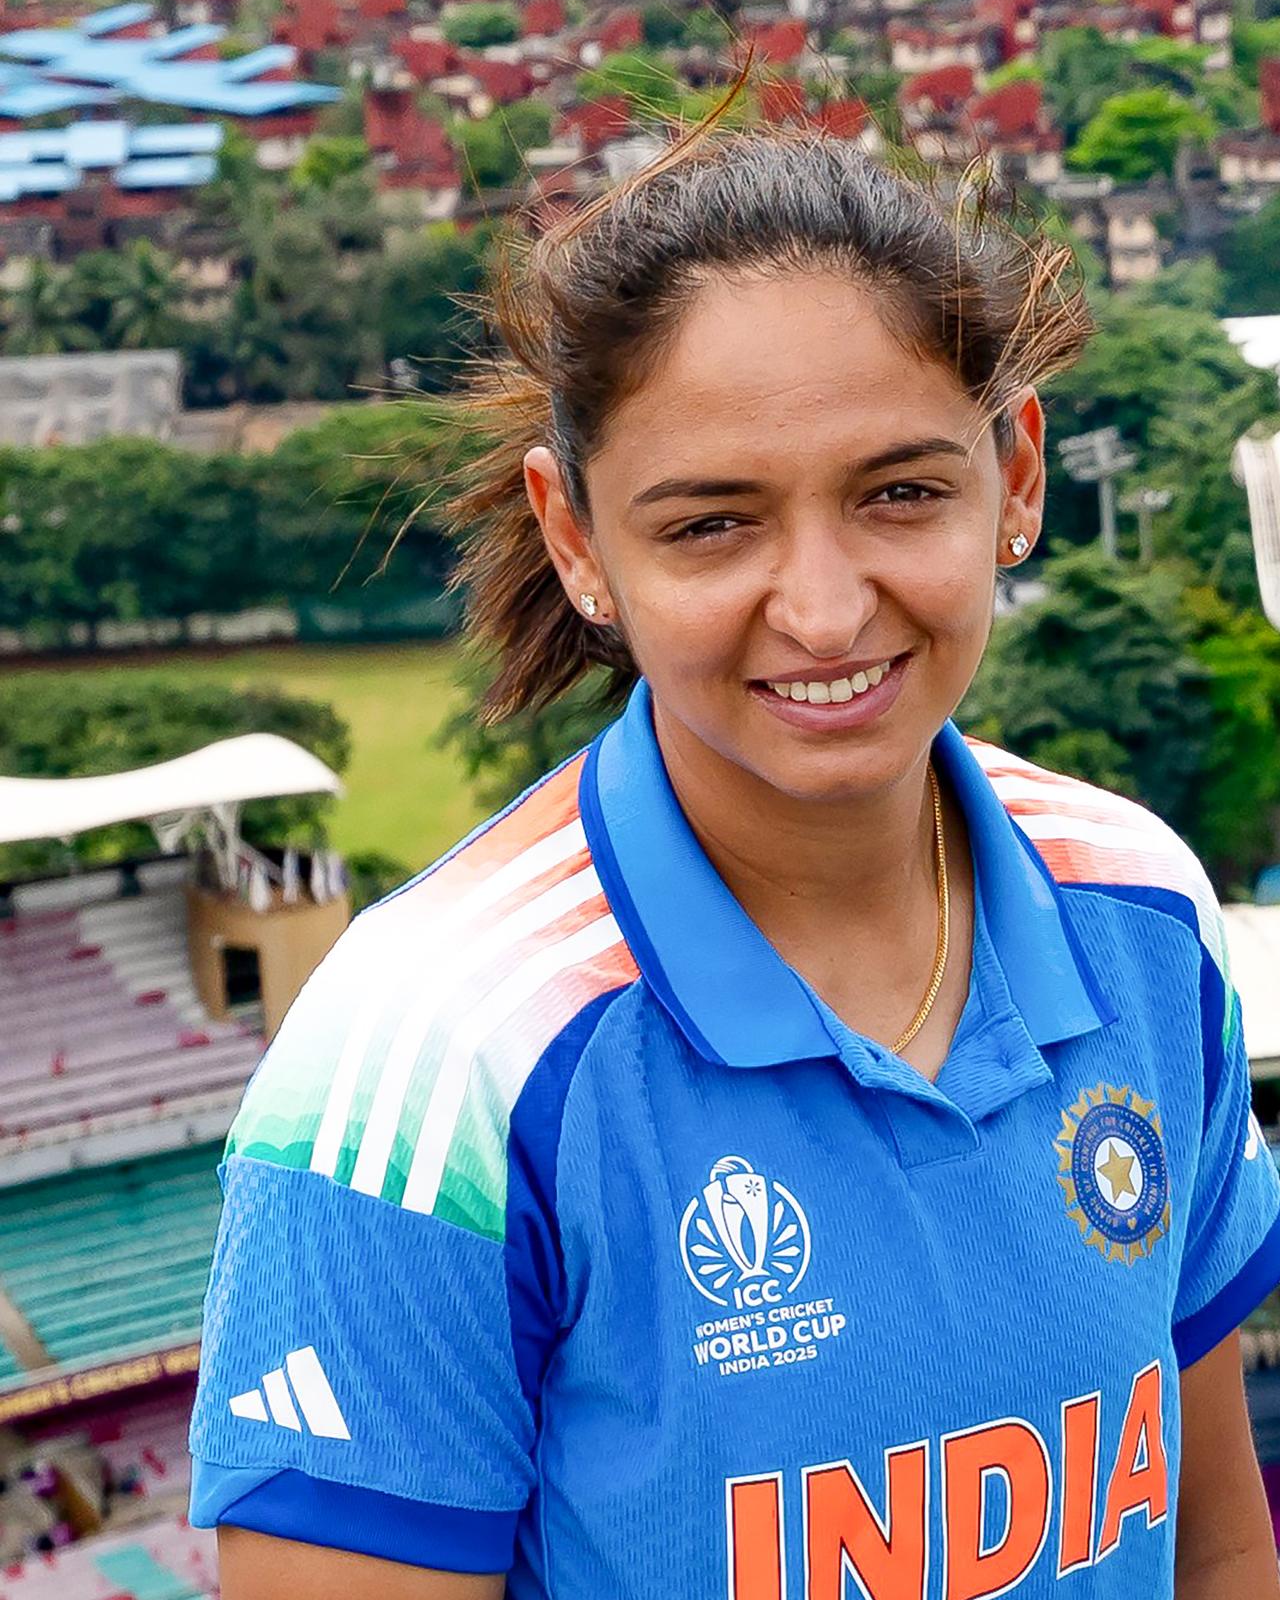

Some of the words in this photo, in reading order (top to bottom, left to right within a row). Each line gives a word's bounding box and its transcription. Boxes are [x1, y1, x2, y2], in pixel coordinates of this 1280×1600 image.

[732, 1279, 782, 1309] ICC
[768, 1298, 834, 1323] CRICKET
[693, 1326, 787, 1366] WORLD
[793, 1314, 846, 1344] CUP
[719, 1354, 770, 1376] INDIA
[774, 1345, 818, 1367] 2025
